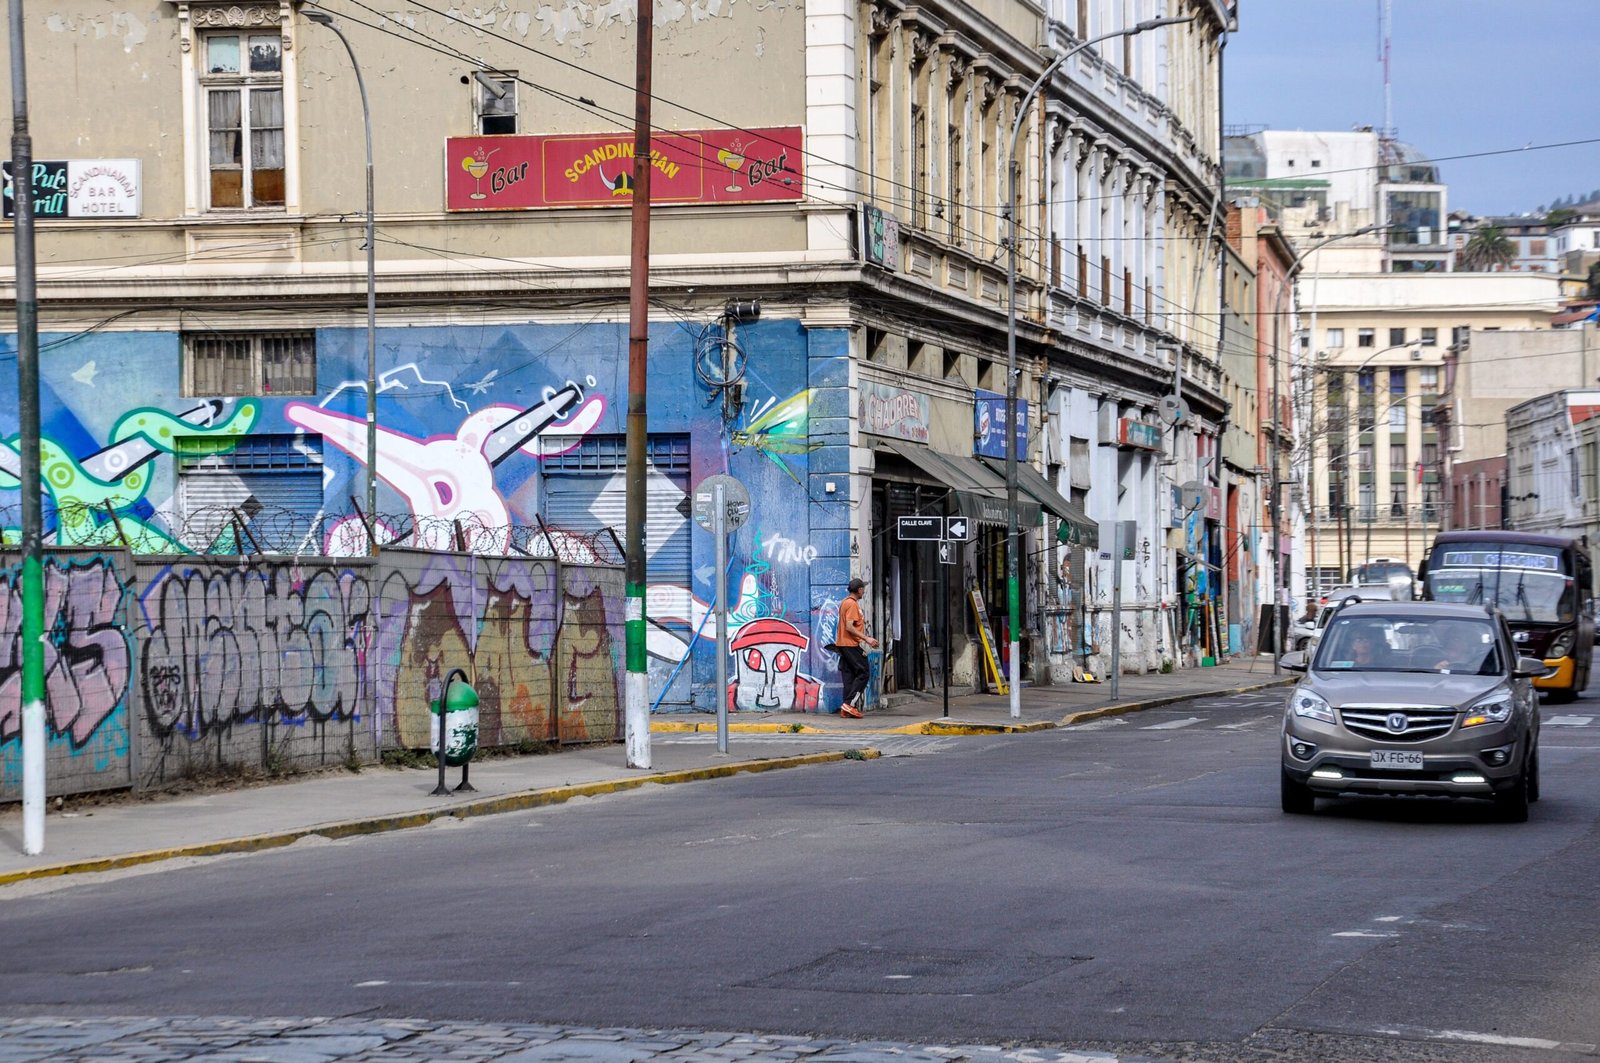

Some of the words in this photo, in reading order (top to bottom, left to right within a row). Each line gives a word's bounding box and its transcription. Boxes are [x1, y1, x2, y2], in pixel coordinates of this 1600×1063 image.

[32, 163, 66, 190] Pub
[564, 142, 680, 182] SCANDINIAN
[748, 153, 787, 187] Bar
[70, 167, 136, 199] SCANDINAVIAN
[88, 187, 116, 197] BAR
[490, 161, 529, 195] Bar
[32, 190, 68, 214] rill
[82, 203, 124, 213] HOTEL
